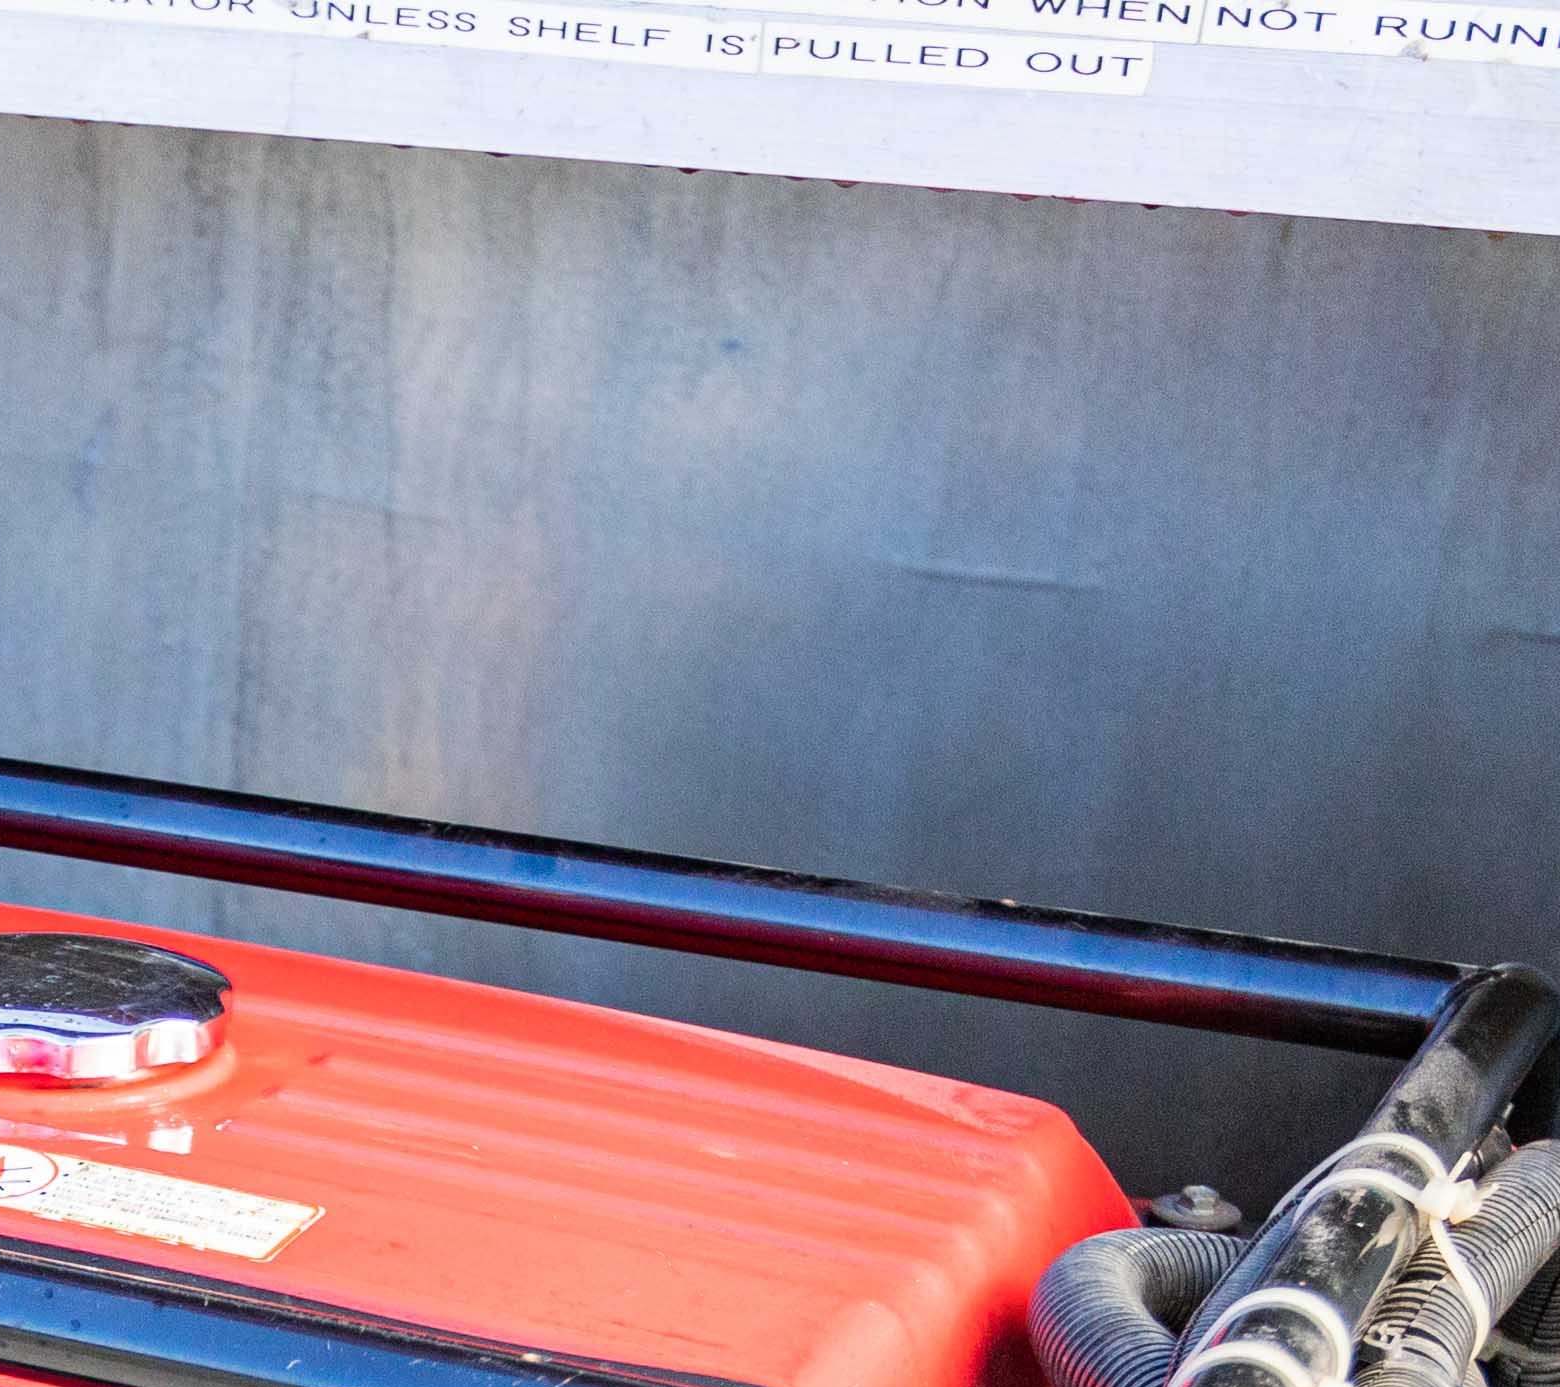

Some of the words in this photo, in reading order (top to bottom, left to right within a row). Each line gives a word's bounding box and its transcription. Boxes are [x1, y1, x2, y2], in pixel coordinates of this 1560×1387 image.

[1032, 0, 1191, 25] WHEN
[1216, 5, 1337, 34] NOT
[507, 15, 670, 49] SHELF
[705, 32, 746, 57] IS
[772, 35, 990, 70] PULLED
[1026, 50, 1144, 79] OUT
